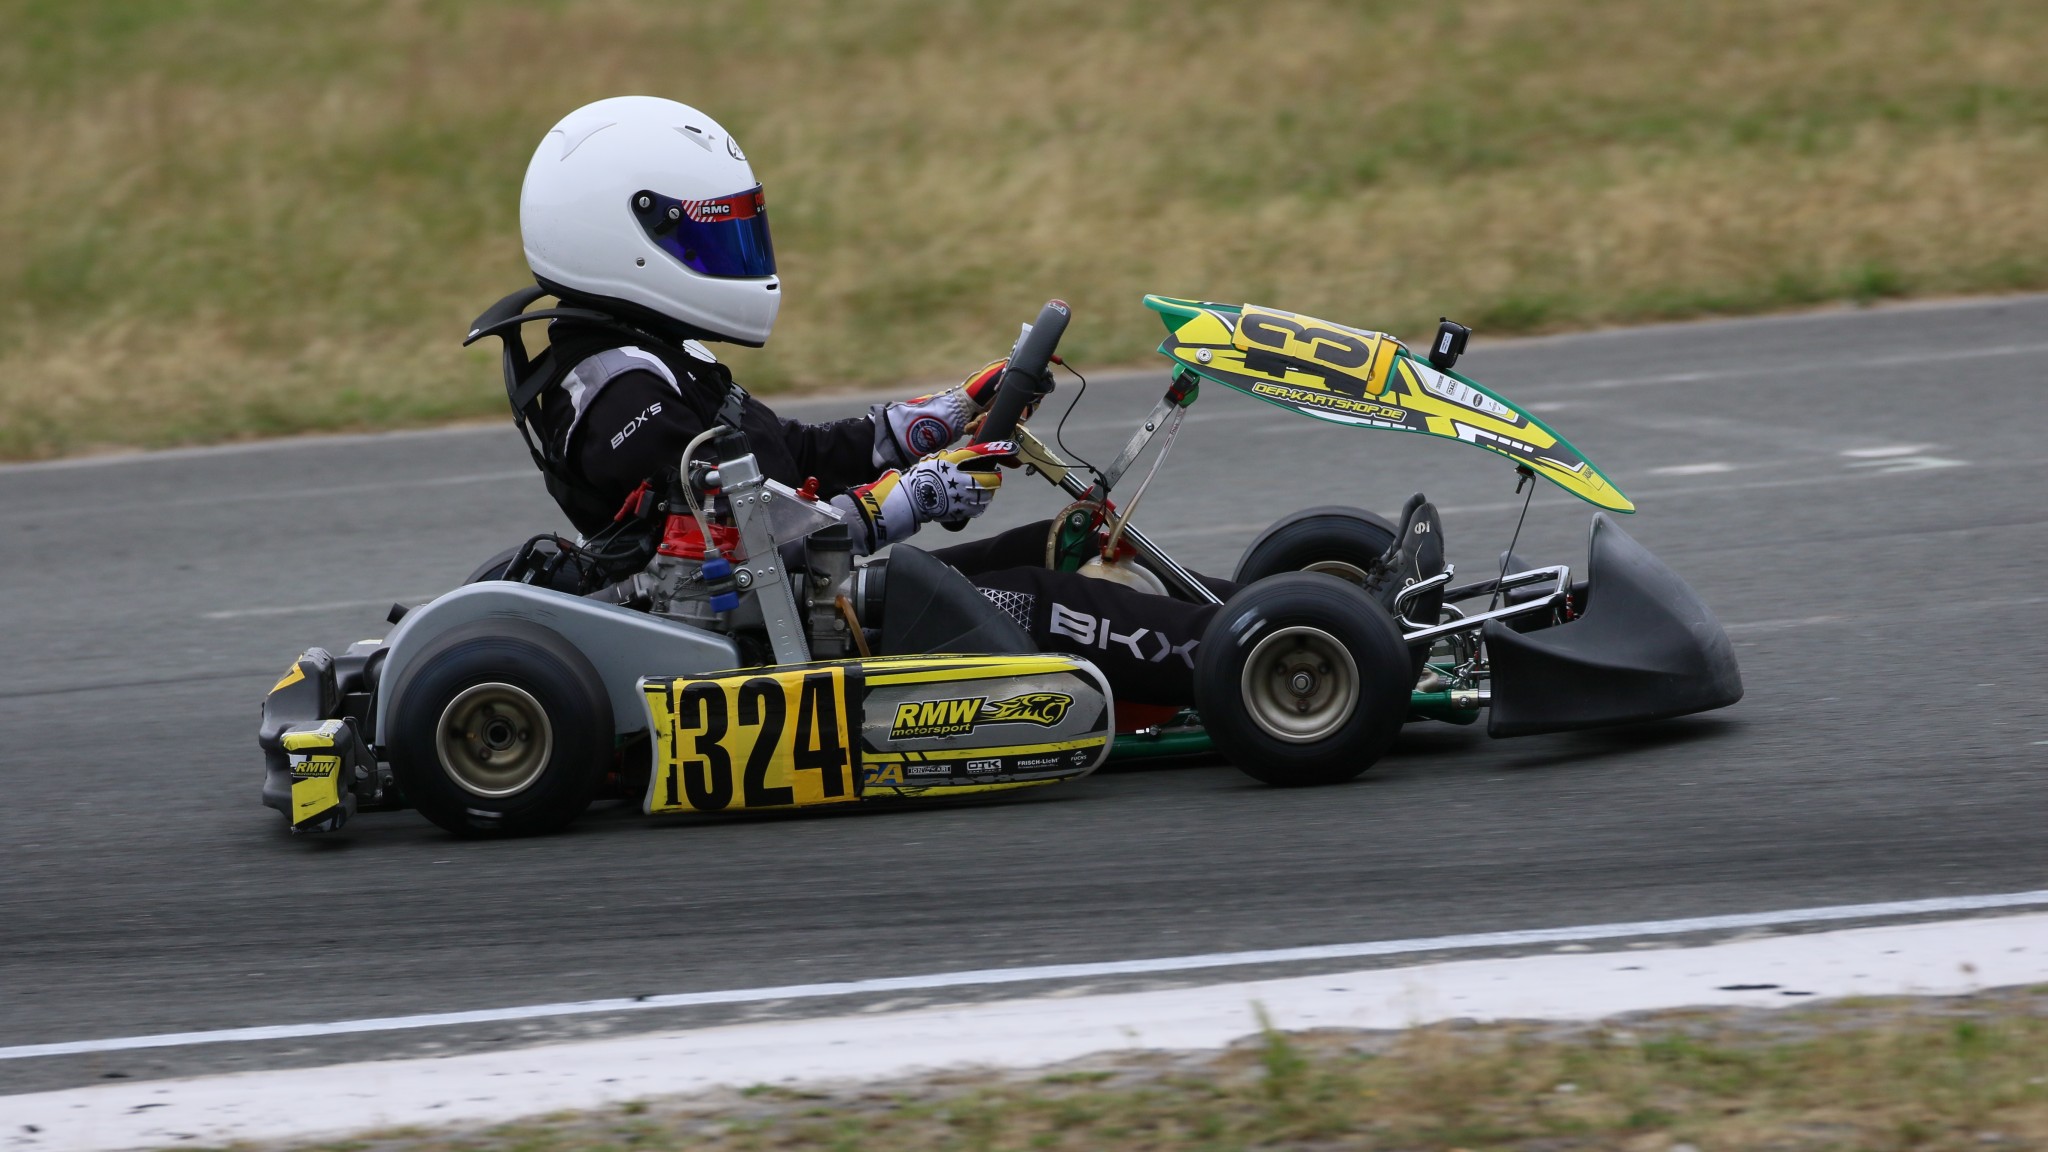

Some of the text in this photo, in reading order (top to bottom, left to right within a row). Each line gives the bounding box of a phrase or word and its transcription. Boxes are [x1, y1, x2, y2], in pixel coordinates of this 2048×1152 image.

[702, 204, 730, 215] RMC
[1254, 383, 1404, 419] DER-KARTSHOP.DE
[610, 401, 662, 450] BOX'S
[893, 699, 982, 728] RMW
[680, 671, 848, 810] 324
[891, 722, 972, 737] motorsport
[296, 762, 334, 772] RMW
[968, 760, 1000, 771] OTK
